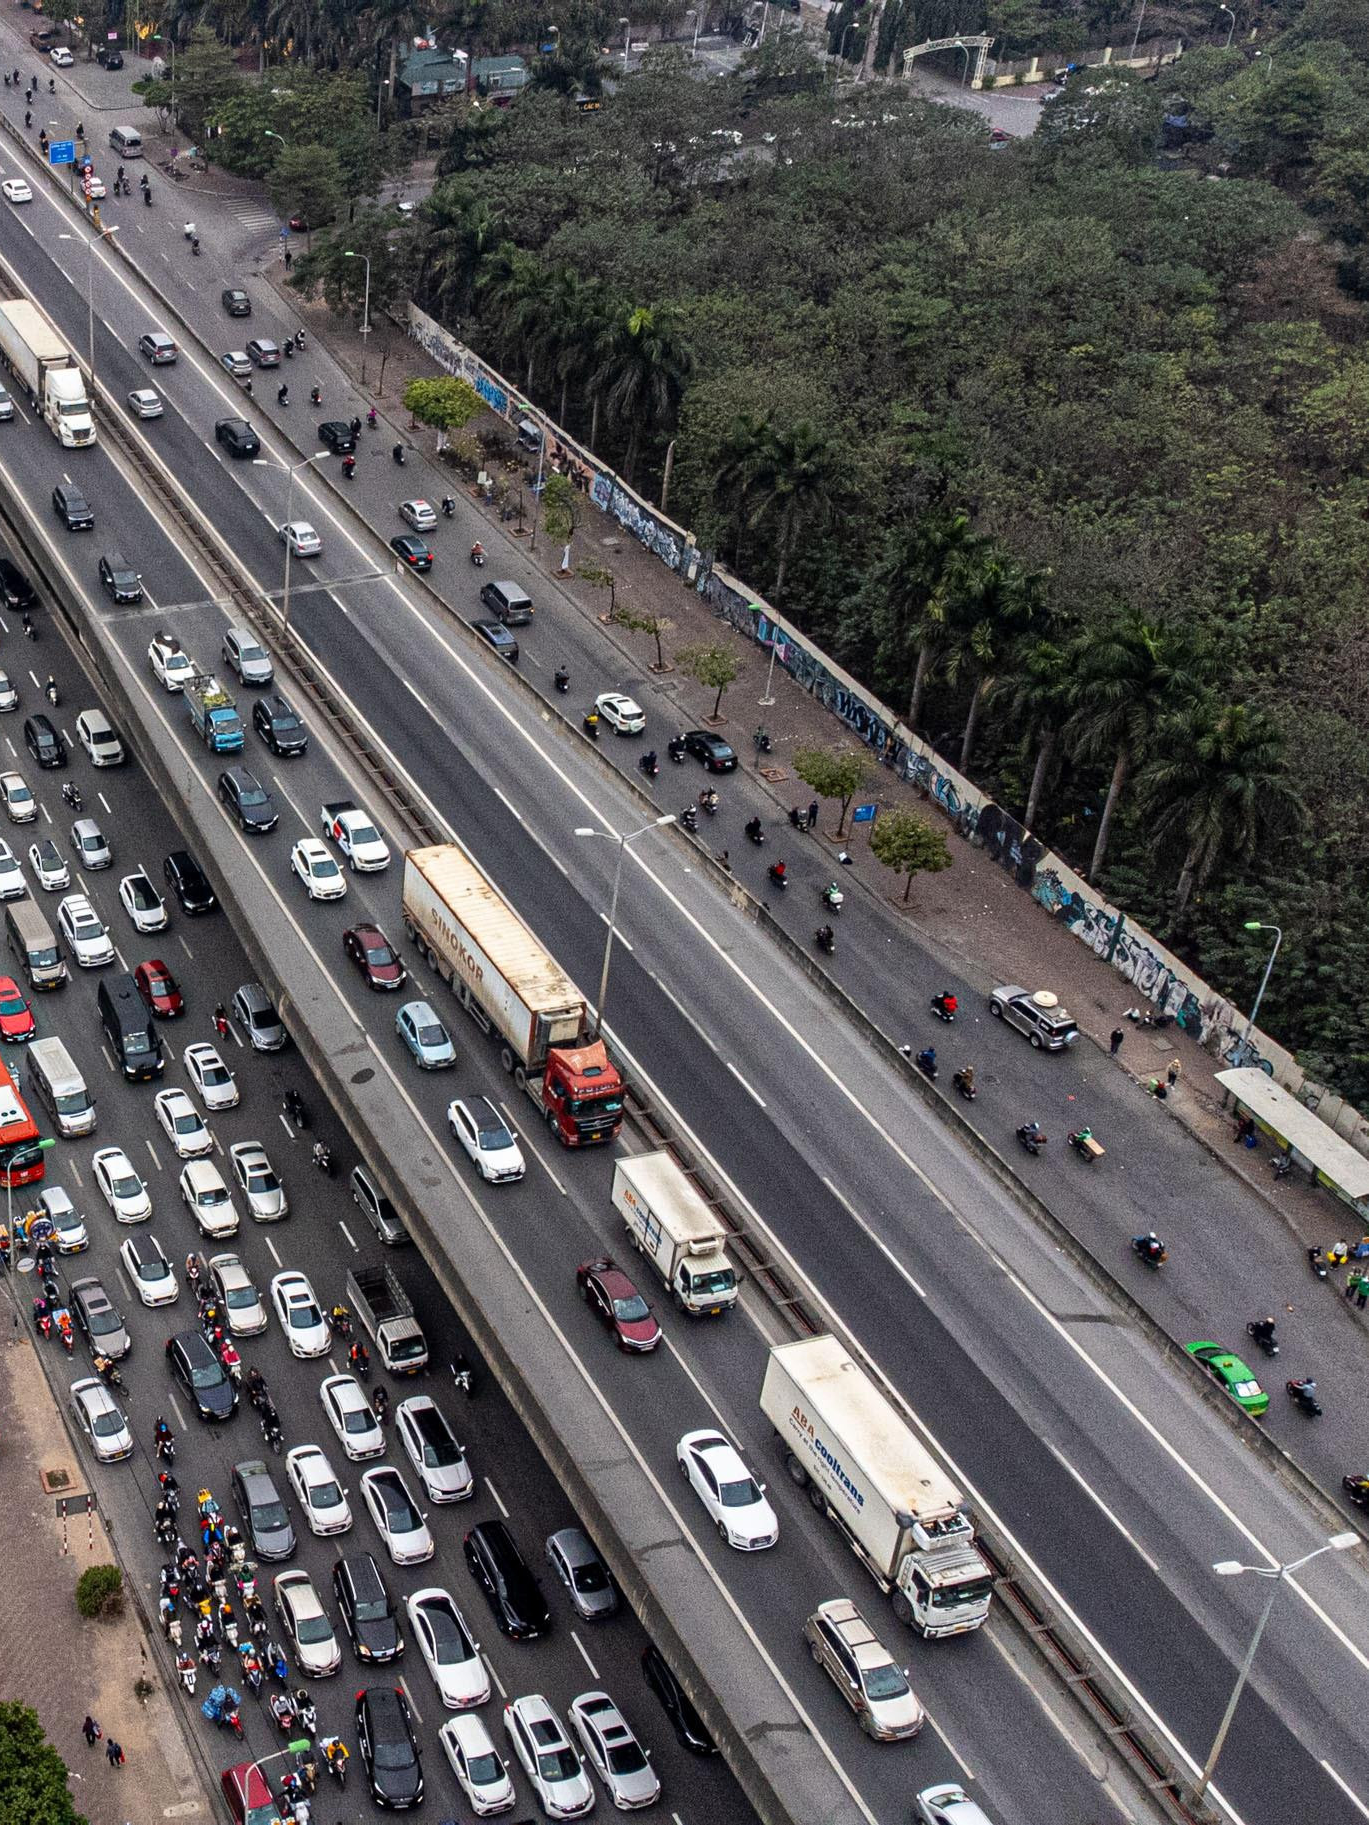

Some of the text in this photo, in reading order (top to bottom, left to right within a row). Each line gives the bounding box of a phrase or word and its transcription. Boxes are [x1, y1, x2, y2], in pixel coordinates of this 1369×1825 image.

[431, 907, 484, 982] SINOKOR
[792, 1406, 817, 1439] ABA
[815, 1438, 865, 1507] cooltrans
